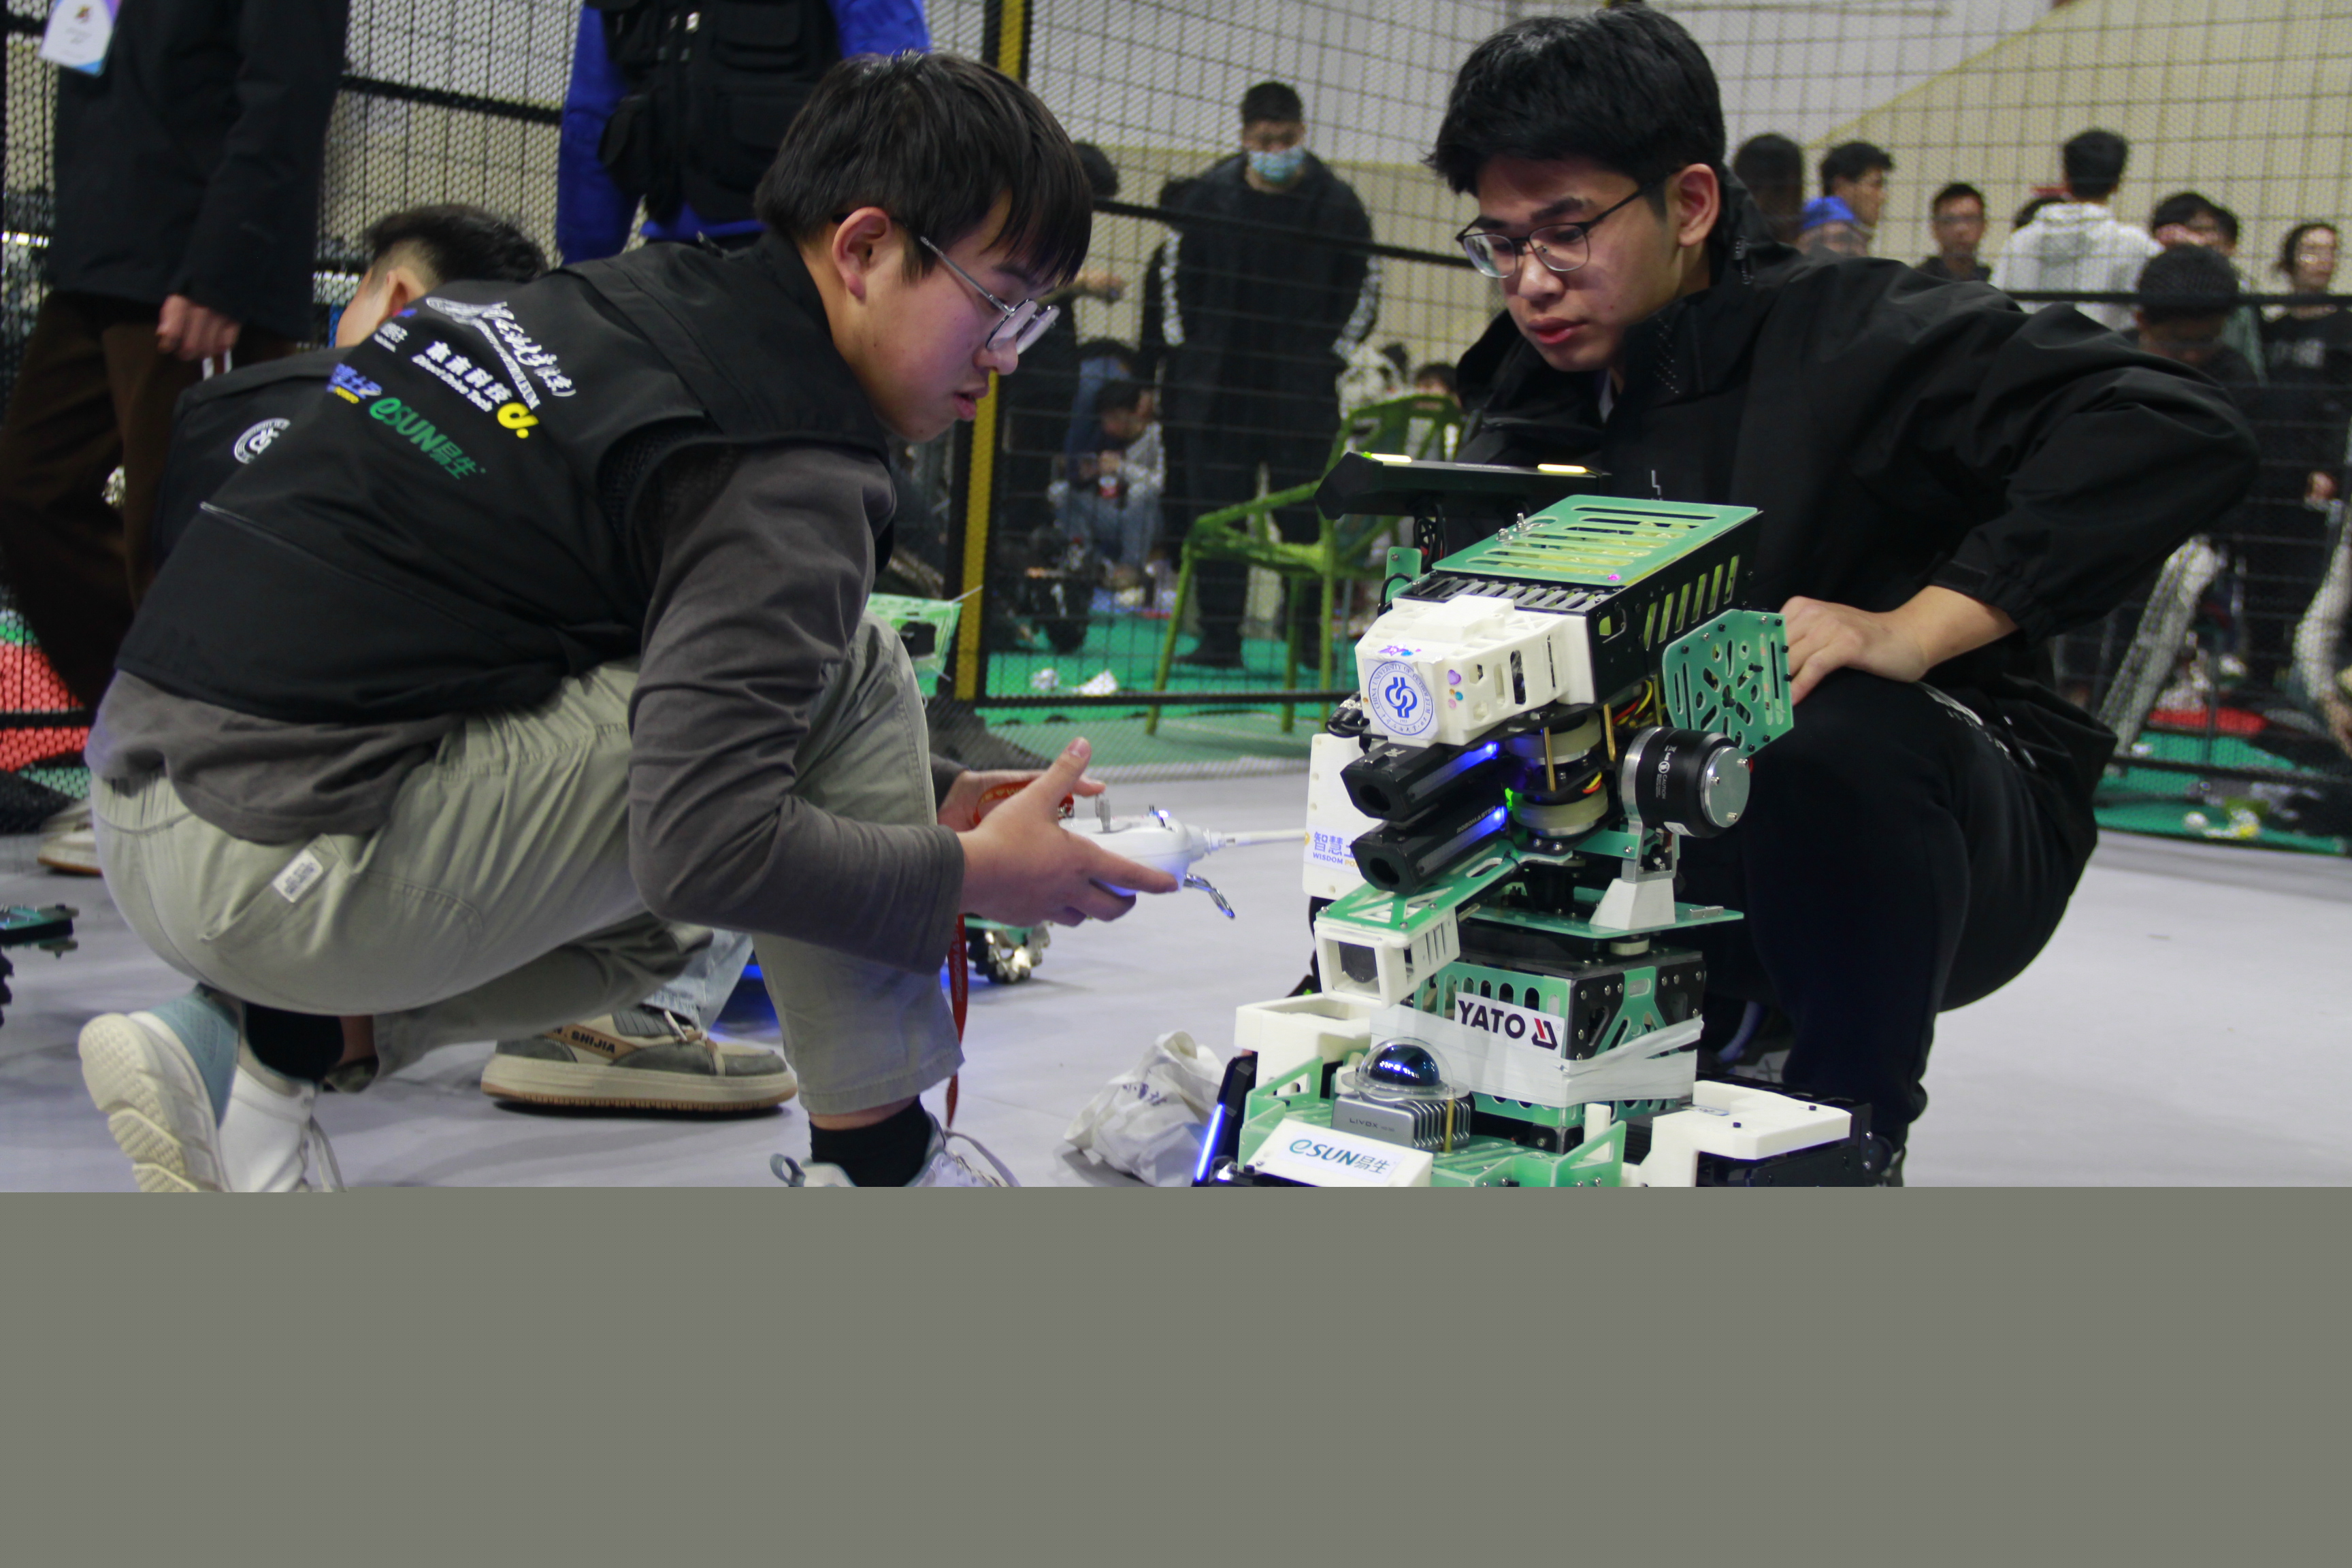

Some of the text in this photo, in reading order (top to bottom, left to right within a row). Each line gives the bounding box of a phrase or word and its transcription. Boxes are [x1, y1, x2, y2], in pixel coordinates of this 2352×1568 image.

[440, 372, 469, 394] Drive
[1372, 664, 1402, 685] UNIVERSITY
[1371, 687, 1380, 709] CHINA
[1457, 806, 1495, 834] ROBOMASTER
[1313, 851, 1358, 868] WISDOM PO
[1458, 1000, 1526, 1039] YATO
[572, 1030, 615, 1053] SHIJIA
[1350, 1117, 1378, 1128] LIVOX
